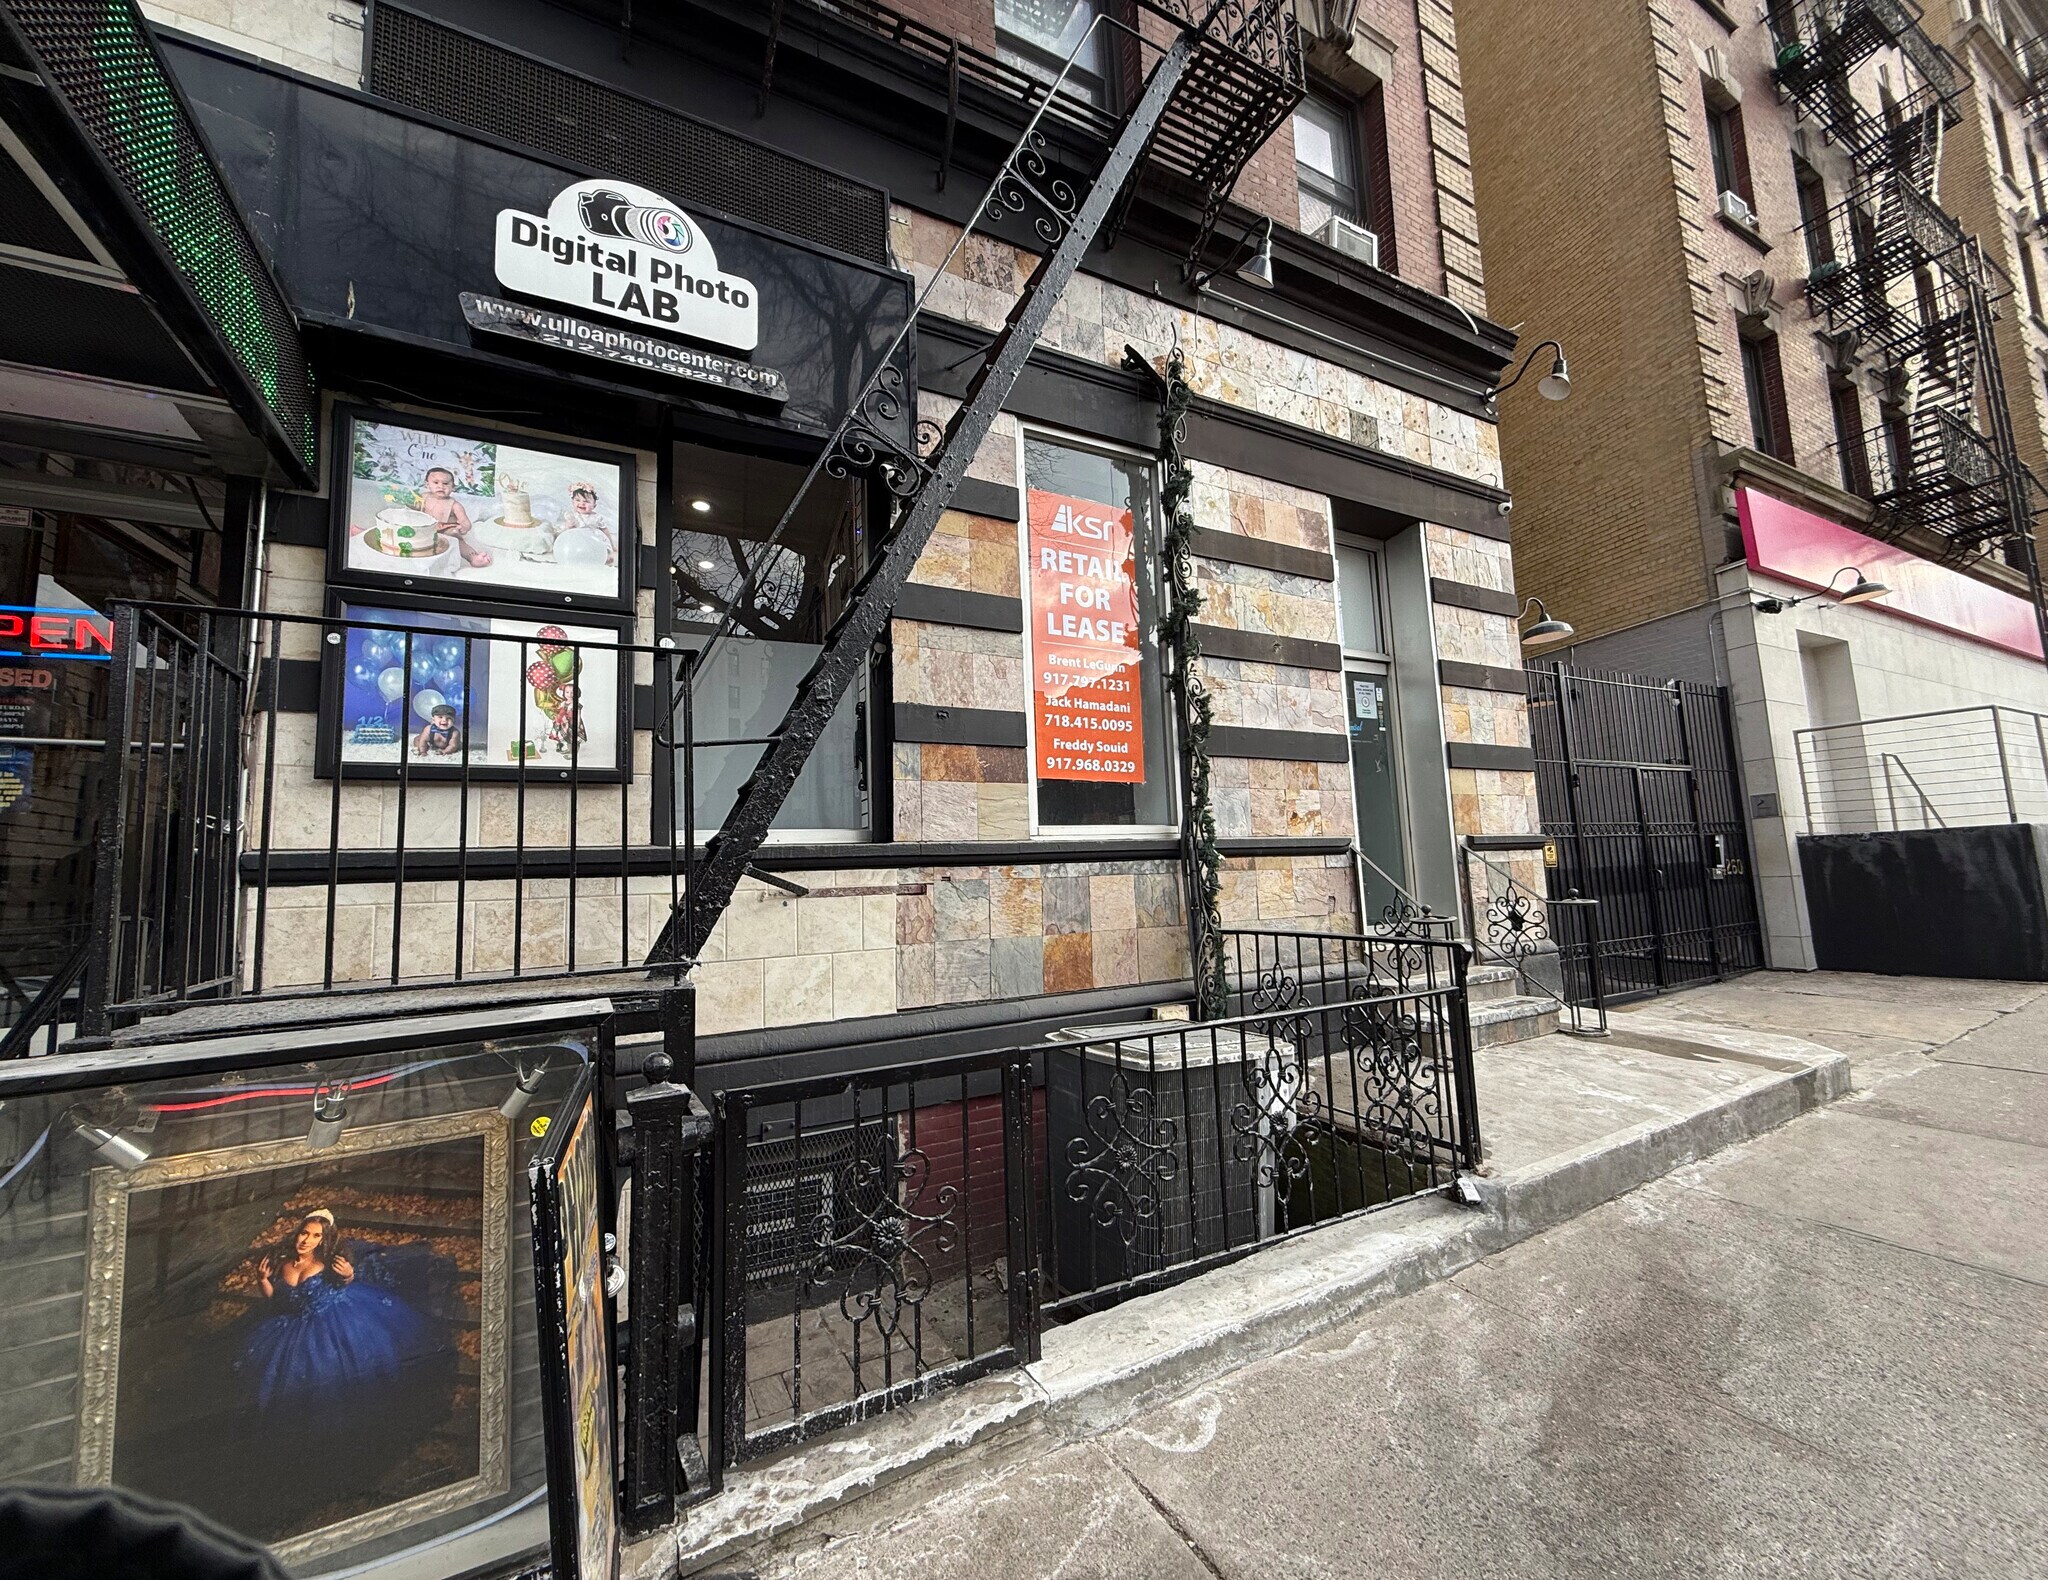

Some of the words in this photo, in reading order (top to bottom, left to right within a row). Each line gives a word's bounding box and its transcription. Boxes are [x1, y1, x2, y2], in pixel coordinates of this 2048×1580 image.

[511, 216, 637, 277] Digital
[650, 257, 749, 309] Photo
[592, 272, 680, 323] LAB
[475, 299, 778, 387] www.ulloaphotocenter.com
[543, 333, 724, 384] 212.740.5828
[1041, 547, 1126, 584] RETAIL
[1059, 582, 1111, 611] FOR
[1047, 612, 1125, 643] LEASE
[1048, 654, 1081, 671] Brent
[1043, 672, 1131, 693] 917.797.1231
[1046, 696, 1072, 709] Jack
[1073, 698, 1131, 714] Hamadani
[1044, 713, 1133, 733] 718.415.0095
[1053, 737, 1098, 753] Freddy
[1099, 740, 1129, 753] Souid
[1046, 757, 1136, 774] 917.968.0329
